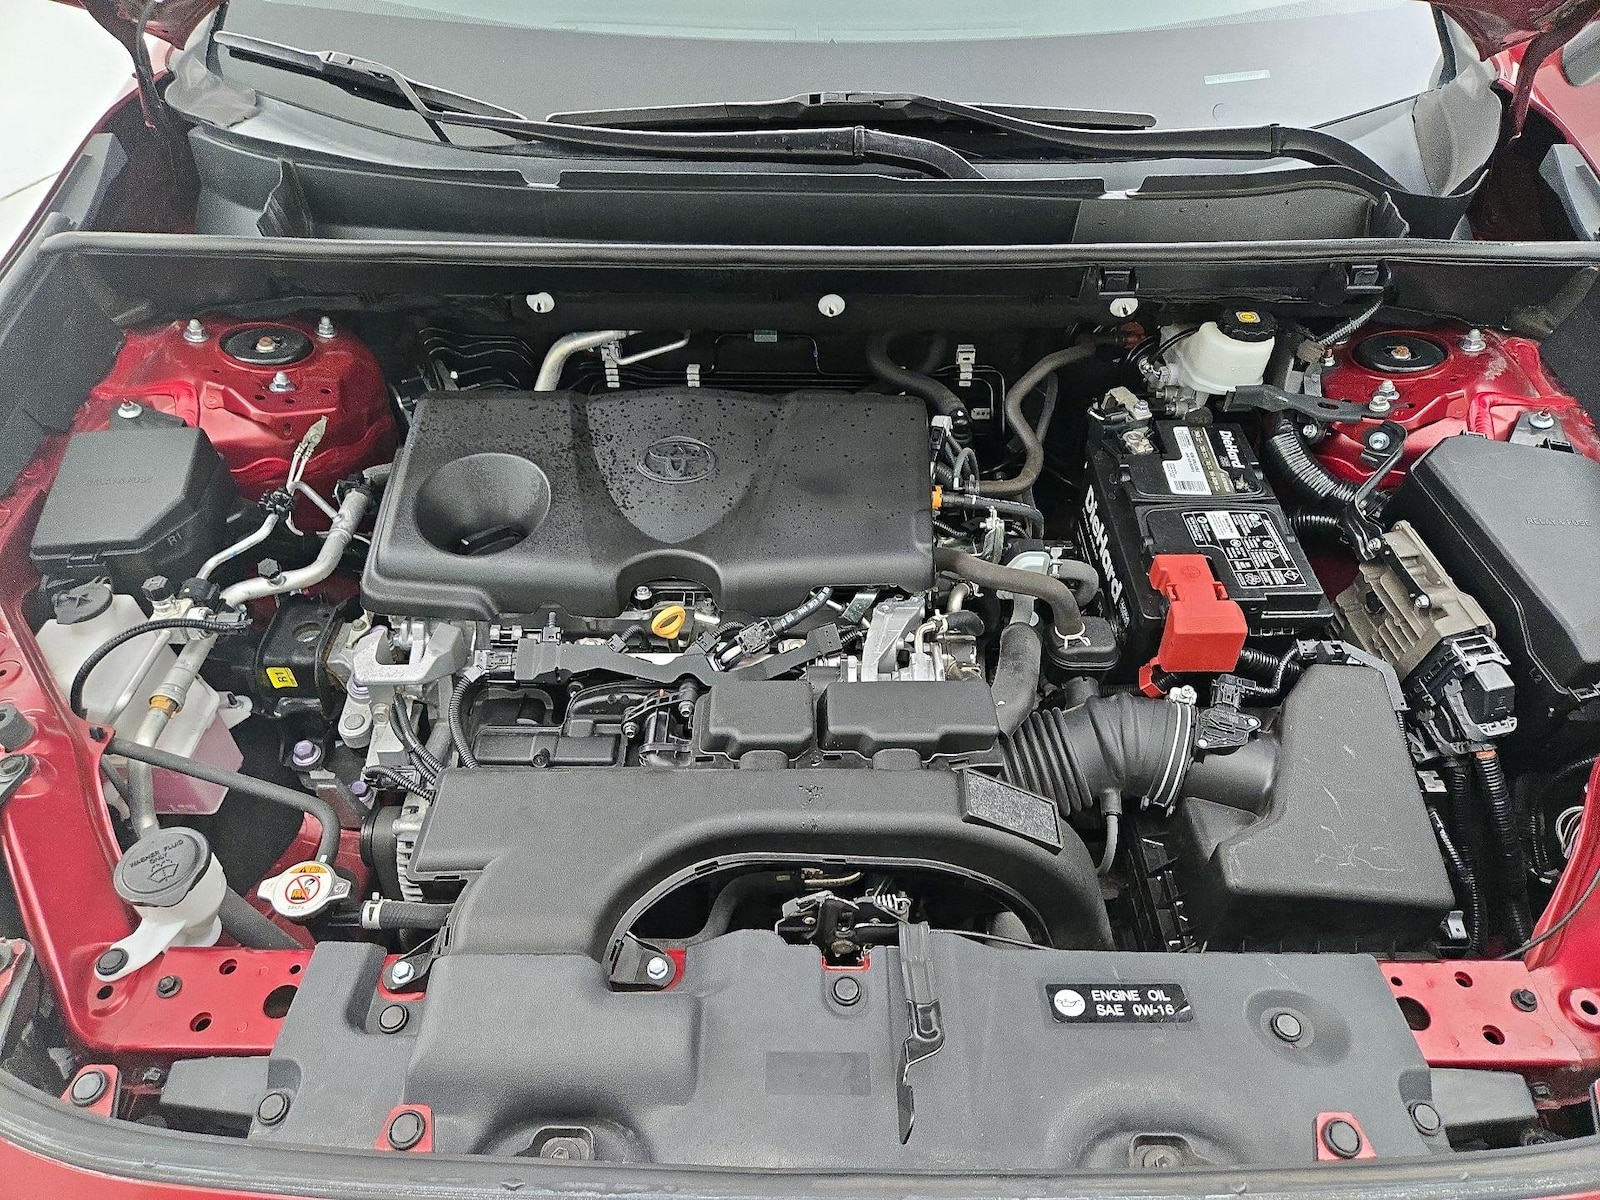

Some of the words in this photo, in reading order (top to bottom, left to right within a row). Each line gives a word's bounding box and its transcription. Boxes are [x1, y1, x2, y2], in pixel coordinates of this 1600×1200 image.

[1219, 430, 1246, 469] DieHard
[1085, 484, 1123, 605] DieHard
[164, 839, 184, 852] FLUID
[150, 852, 168, 864] ONLY
[1091, 989, 1141, 1002] ENGINE
[1147, 989, 1171, 1001] OIL
[1096, 1003, 1125, 1017] SAE
[1132, 1004, 1175, 1017] 0W-16
